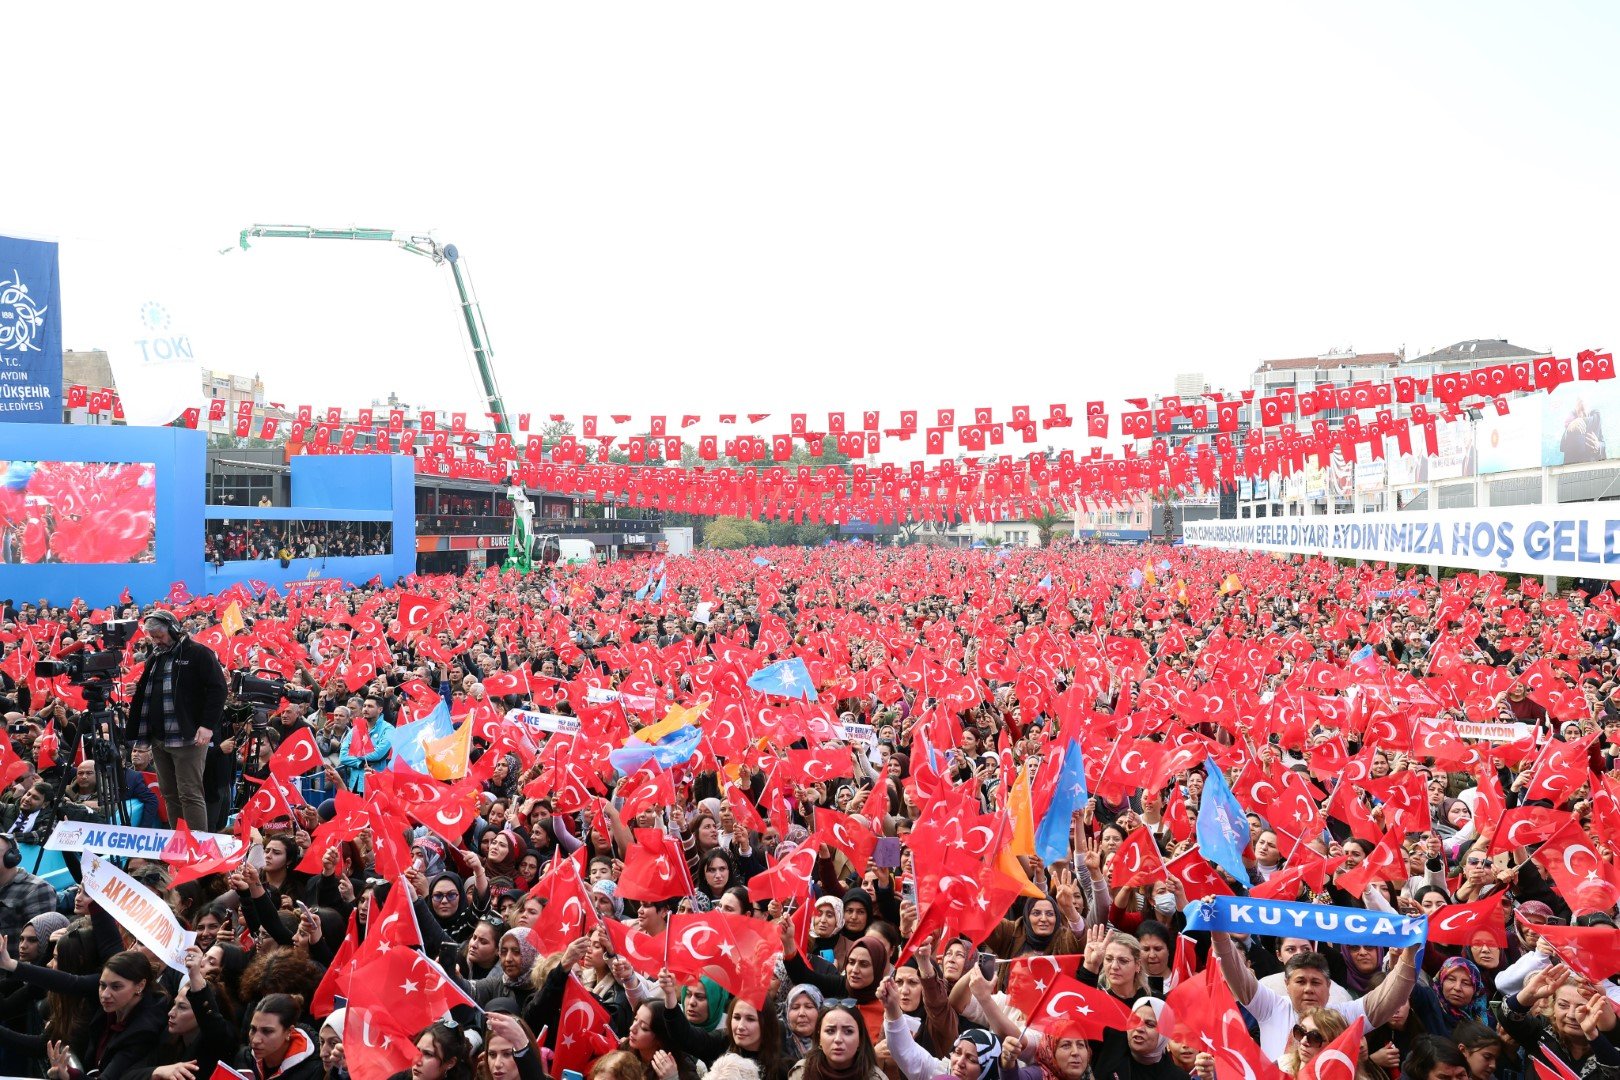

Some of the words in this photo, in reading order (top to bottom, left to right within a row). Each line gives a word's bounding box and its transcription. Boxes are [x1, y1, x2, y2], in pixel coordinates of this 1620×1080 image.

[5, 357, 21, 367] T.C.
[1, 372, 28, 380] AYDIN
[491, 536, 511, 547] BURGE
[1256, 524, 1289, 545] EFELER
[1291, 523, 1329, 549] DİYARI
[1331, 522, 1444, 554] AYDIN'IMIZA
[1451, 521, 1515, 568] HOŞ
[1485, 725, 1515, 737] AYDIN
[83, 830, 107, 847] AK
[107, 831, 169, 853] GENÇLİK
[101, 876, 127, 902] AK
[118, 887, 158, 926] KADIN
[145, 913, 175, 948] AYDIN
[1229, 904, 1425, 936] KUYUCAK
